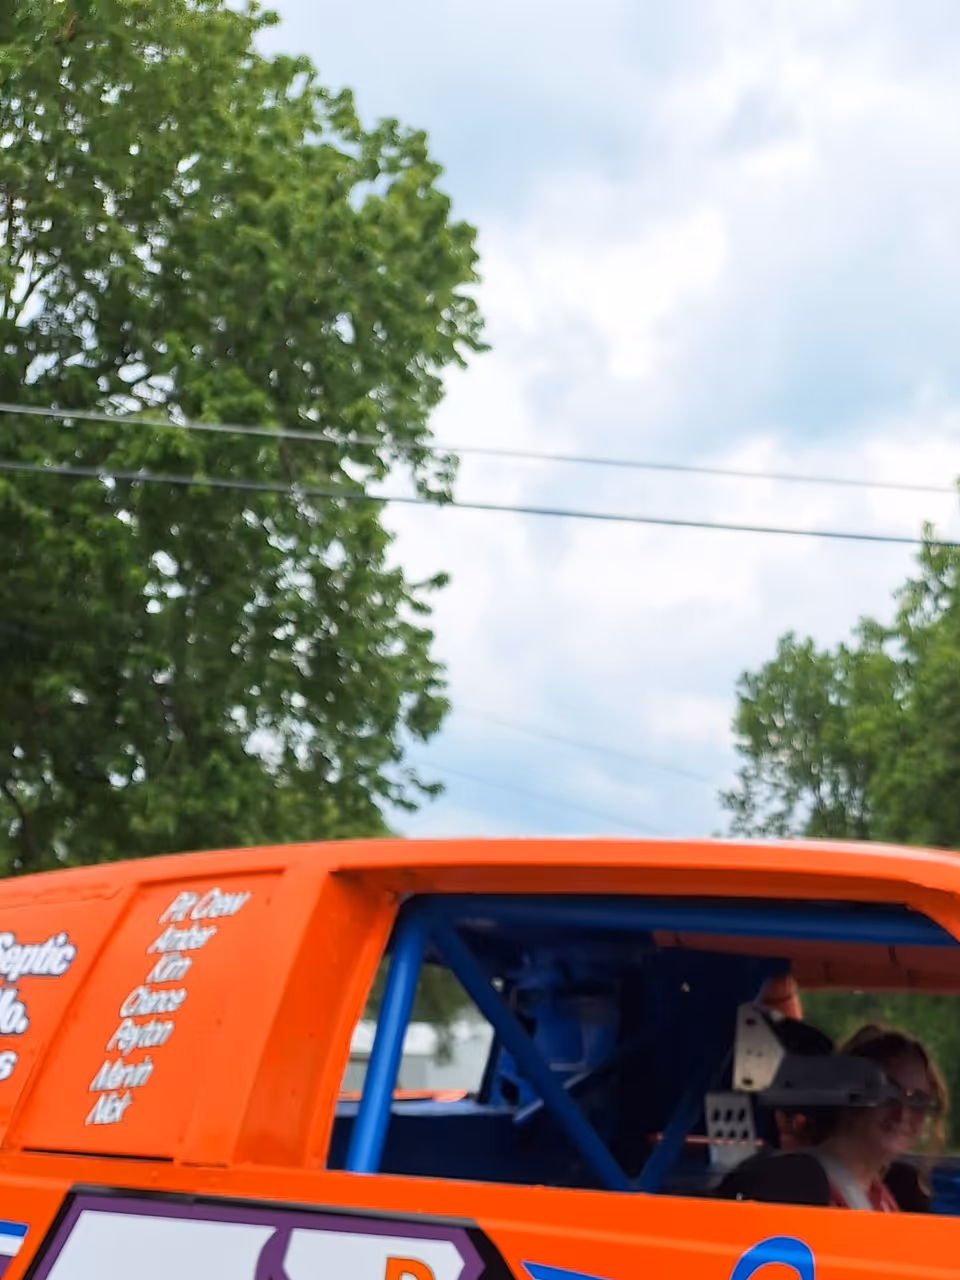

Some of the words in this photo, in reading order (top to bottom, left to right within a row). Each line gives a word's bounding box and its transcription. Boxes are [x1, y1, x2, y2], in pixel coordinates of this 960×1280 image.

[189, 887, 252, 920] Crew
[145, 951, 192, 984] Kim
[119, 985, 187, 1018] Chance
[105, 1016, 175, 1058] Peyton
